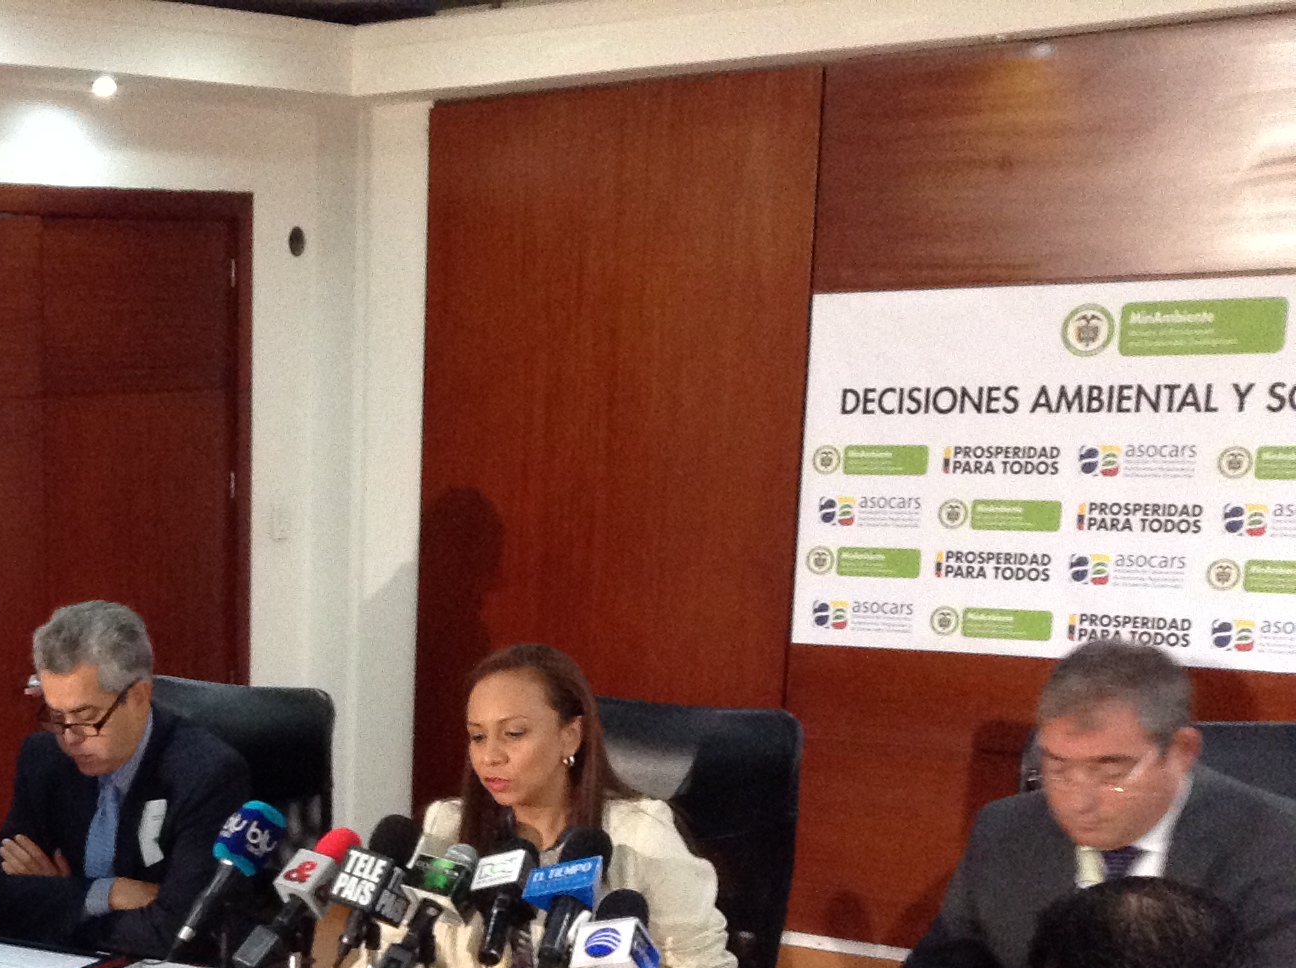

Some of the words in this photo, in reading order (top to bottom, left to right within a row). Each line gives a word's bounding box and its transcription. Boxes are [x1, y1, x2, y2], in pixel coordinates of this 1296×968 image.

[840, 385, 1020, 415] DECISIONES
[1029, 383, 1219, 413] AMBIENTAL
[1232, 382, 1255, 412] Y
[953, 445, 1061, 460] PROSPERIDAD
[1124, 443, 1198, 458] asocars
[952, 460, 996, 475] PARA
[1001, 460, 1060, 476] TODOS
[858, 496, 922, 510] asocars
[1088, 502, 1204, 518] PROSPERIDAD
[1087, 517, 1133, 532] PARA
[1140, 518, 1202, 534] TODOS
[945, 551, 1052, 567] PROSPERIDAD
[1114, 553, 1186, 569] asocars
[944, 566, 987, 580] PARA
[993, 566, 1051, 582] TODOS
[852, 600, 914, 615] asocars
[1078, 613, 1192, 632] PROSPERIDAD
[1130, 630, 1191, 648] TODOS
[345, 850, 388, 883] TELE
